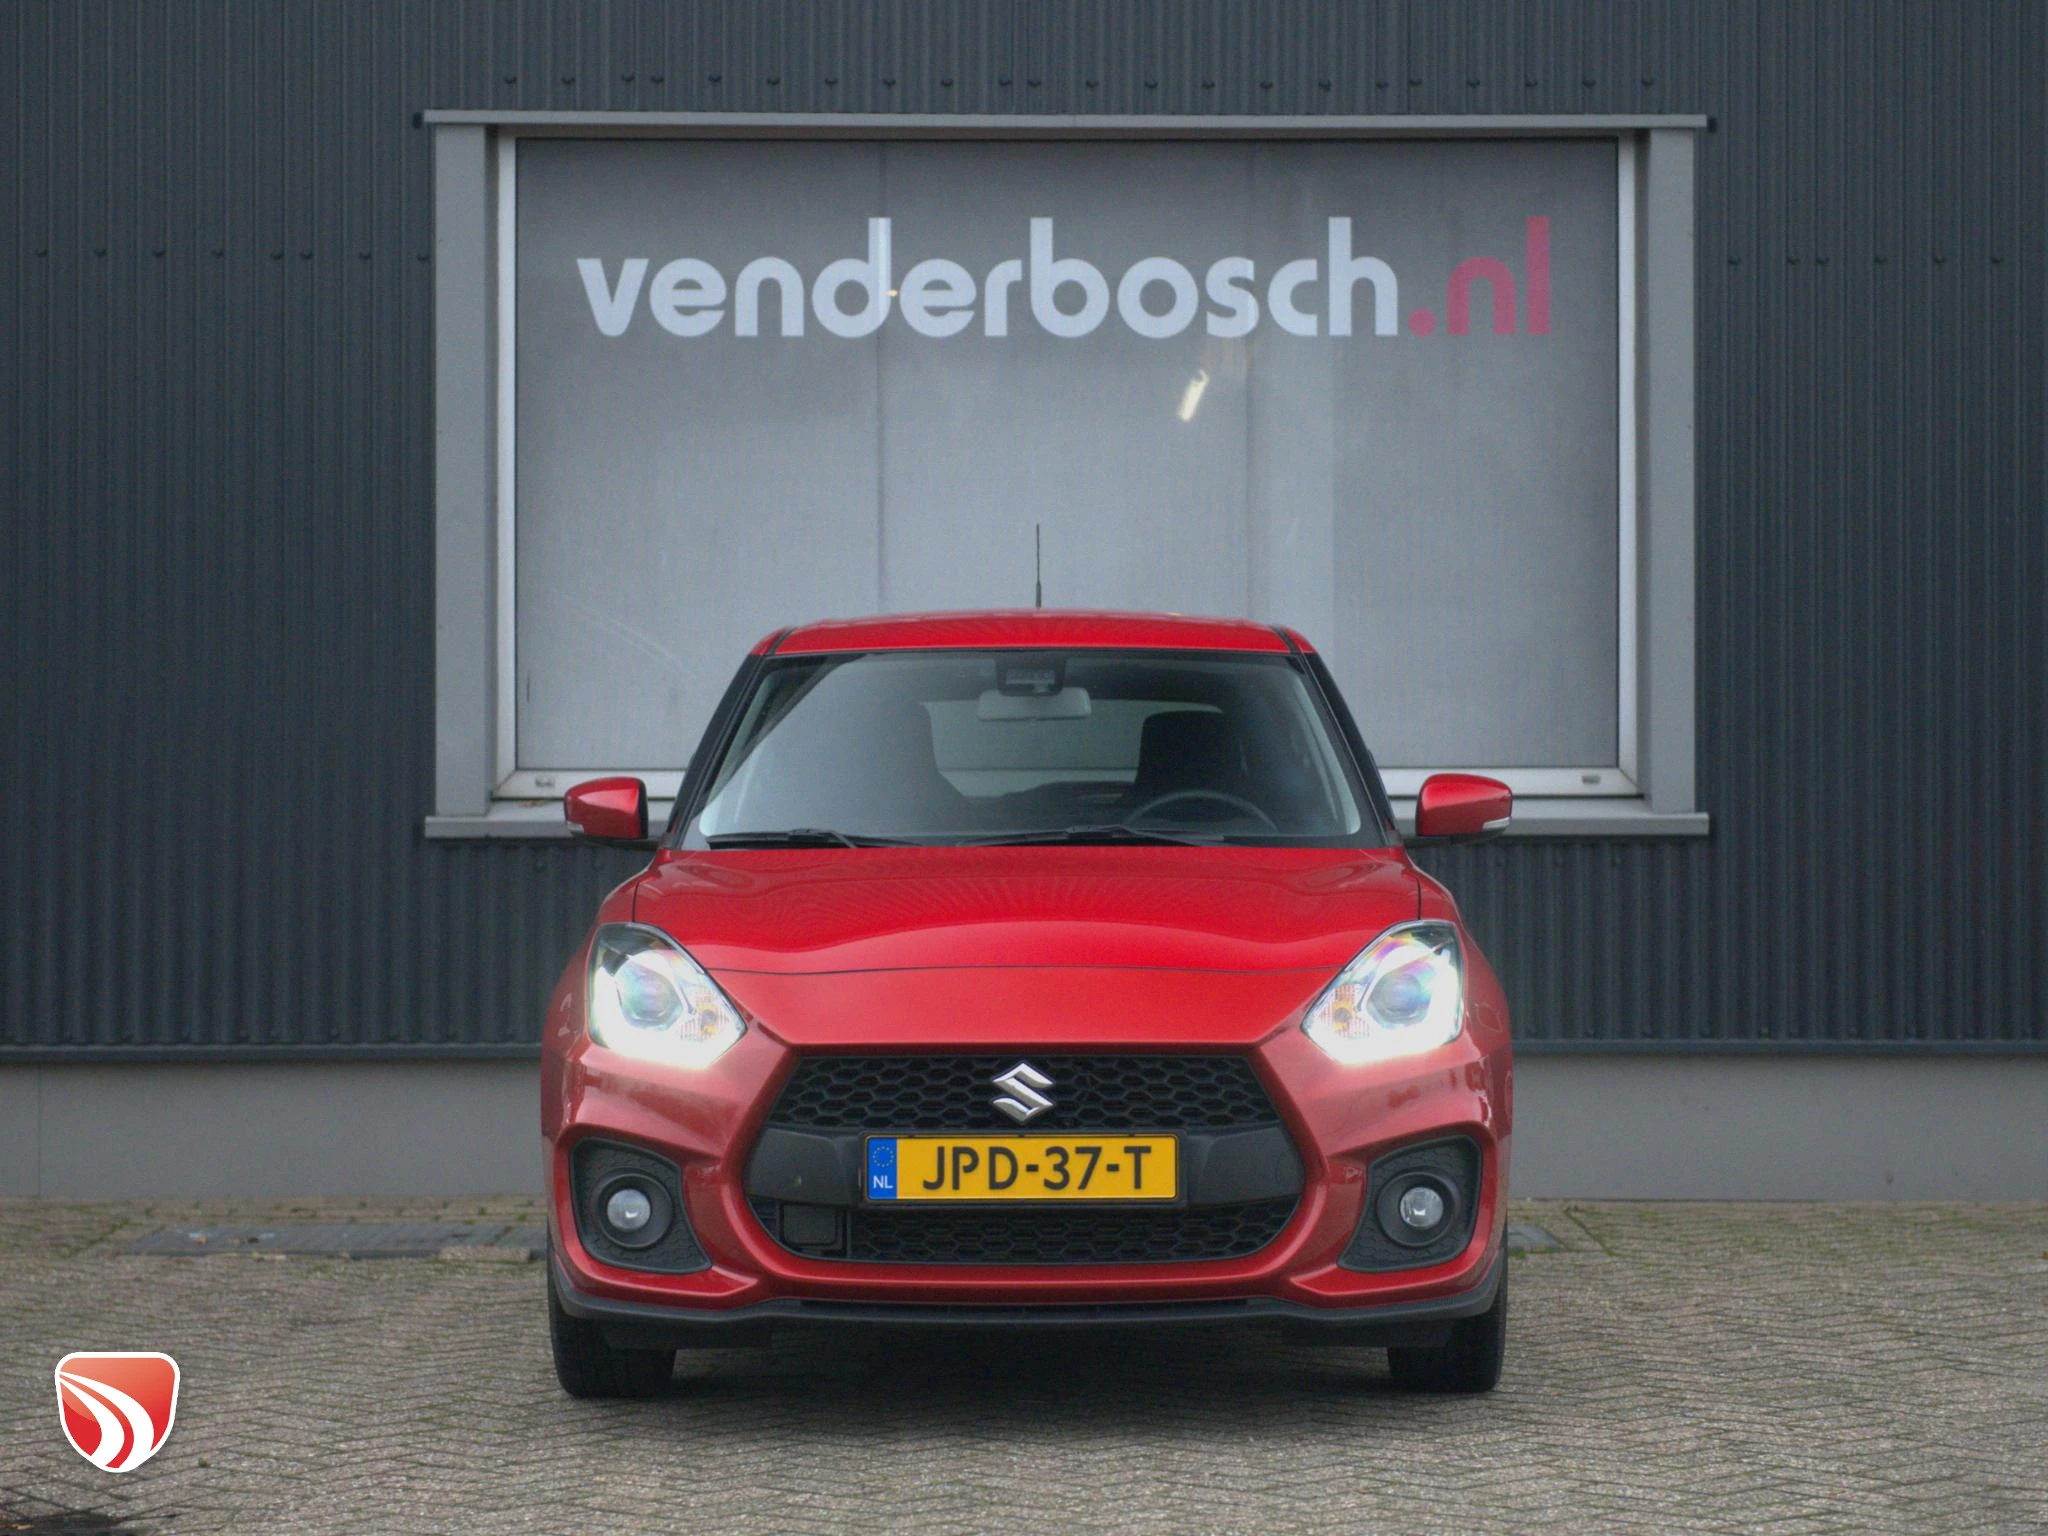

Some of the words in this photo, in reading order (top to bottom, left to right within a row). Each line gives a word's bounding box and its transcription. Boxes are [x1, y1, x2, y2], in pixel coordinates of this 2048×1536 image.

[577, 216, 1551, 338] venderbosch.nl
[872, 1175, 893, 1189] NL
[922, 1146, 1152, 1190] JPD-37-T
